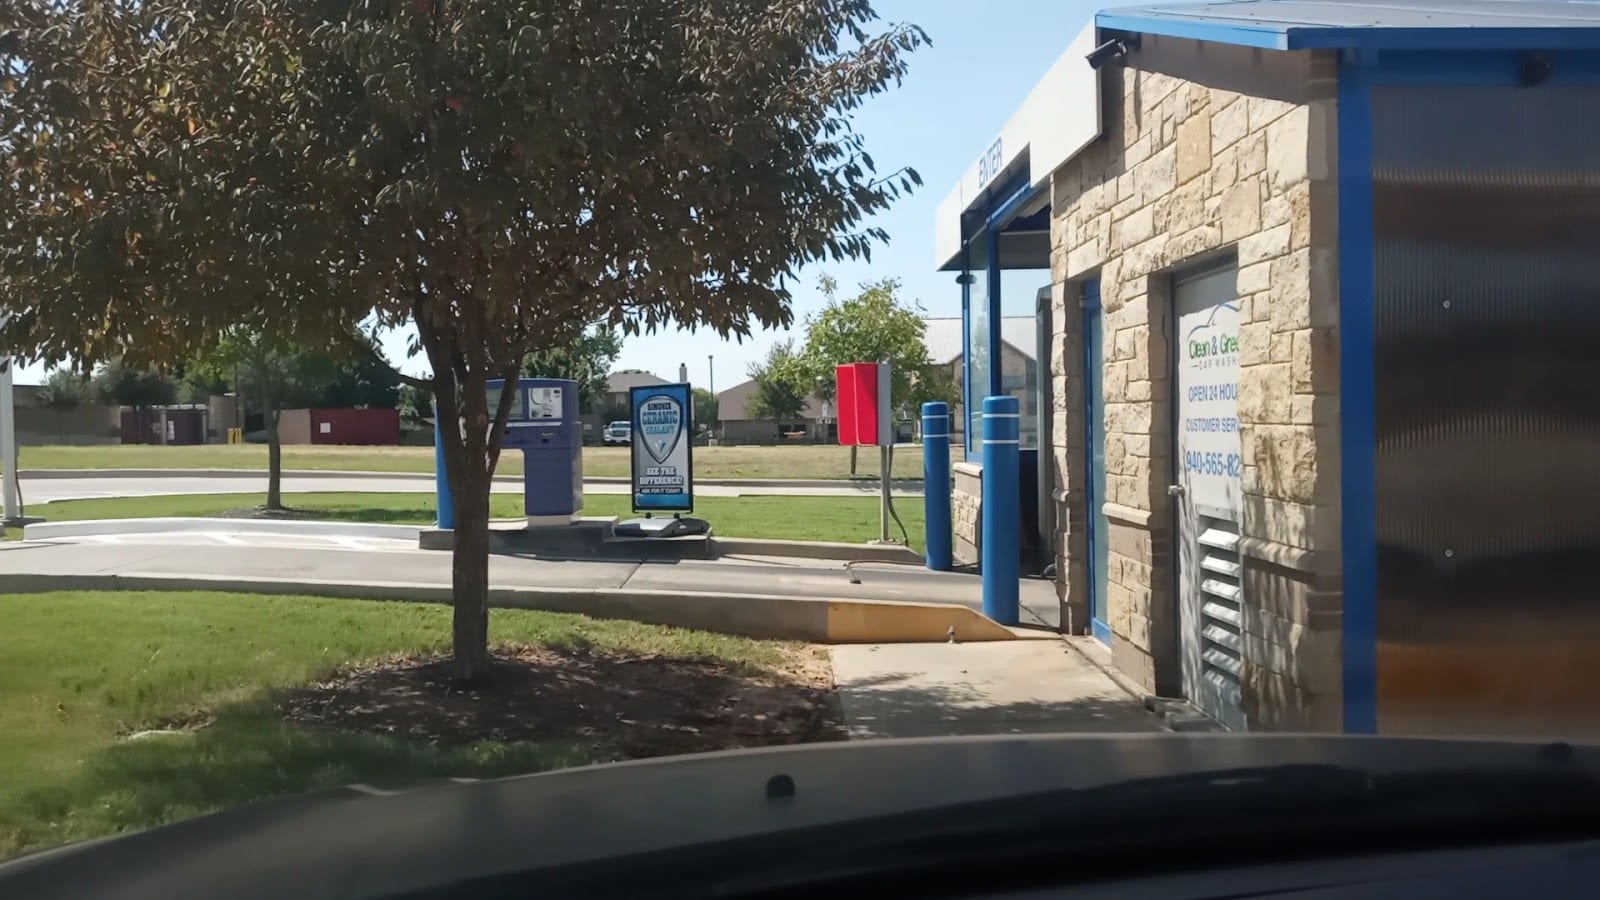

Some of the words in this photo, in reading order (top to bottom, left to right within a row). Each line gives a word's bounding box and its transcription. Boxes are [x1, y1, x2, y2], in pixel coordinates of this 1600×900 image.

[979, 136, 1002, 189] ENTER
[1189, 340, 1210, 359] Clean
[1211, 335, 1218, 356] &
[1199, 360, 1212, 371] CAR
[1188, 385, 1208, 402] OPEN
[1209, 384, 1218, 401] 24
[1219, 383, 1239, 401] HOU
[642, 411, 677, 425] CERAMIC
[1186, 417, 1220, 432] CUSTOMER
[1221, 417, 1240, 432] SERV
[646, 467, 660, 476] SEE
[660, 466, 675, 476] THE
[1186, 450, 1240, 477] 940-565-82
[640, 476, 683, 486] DIFFERENCE!
